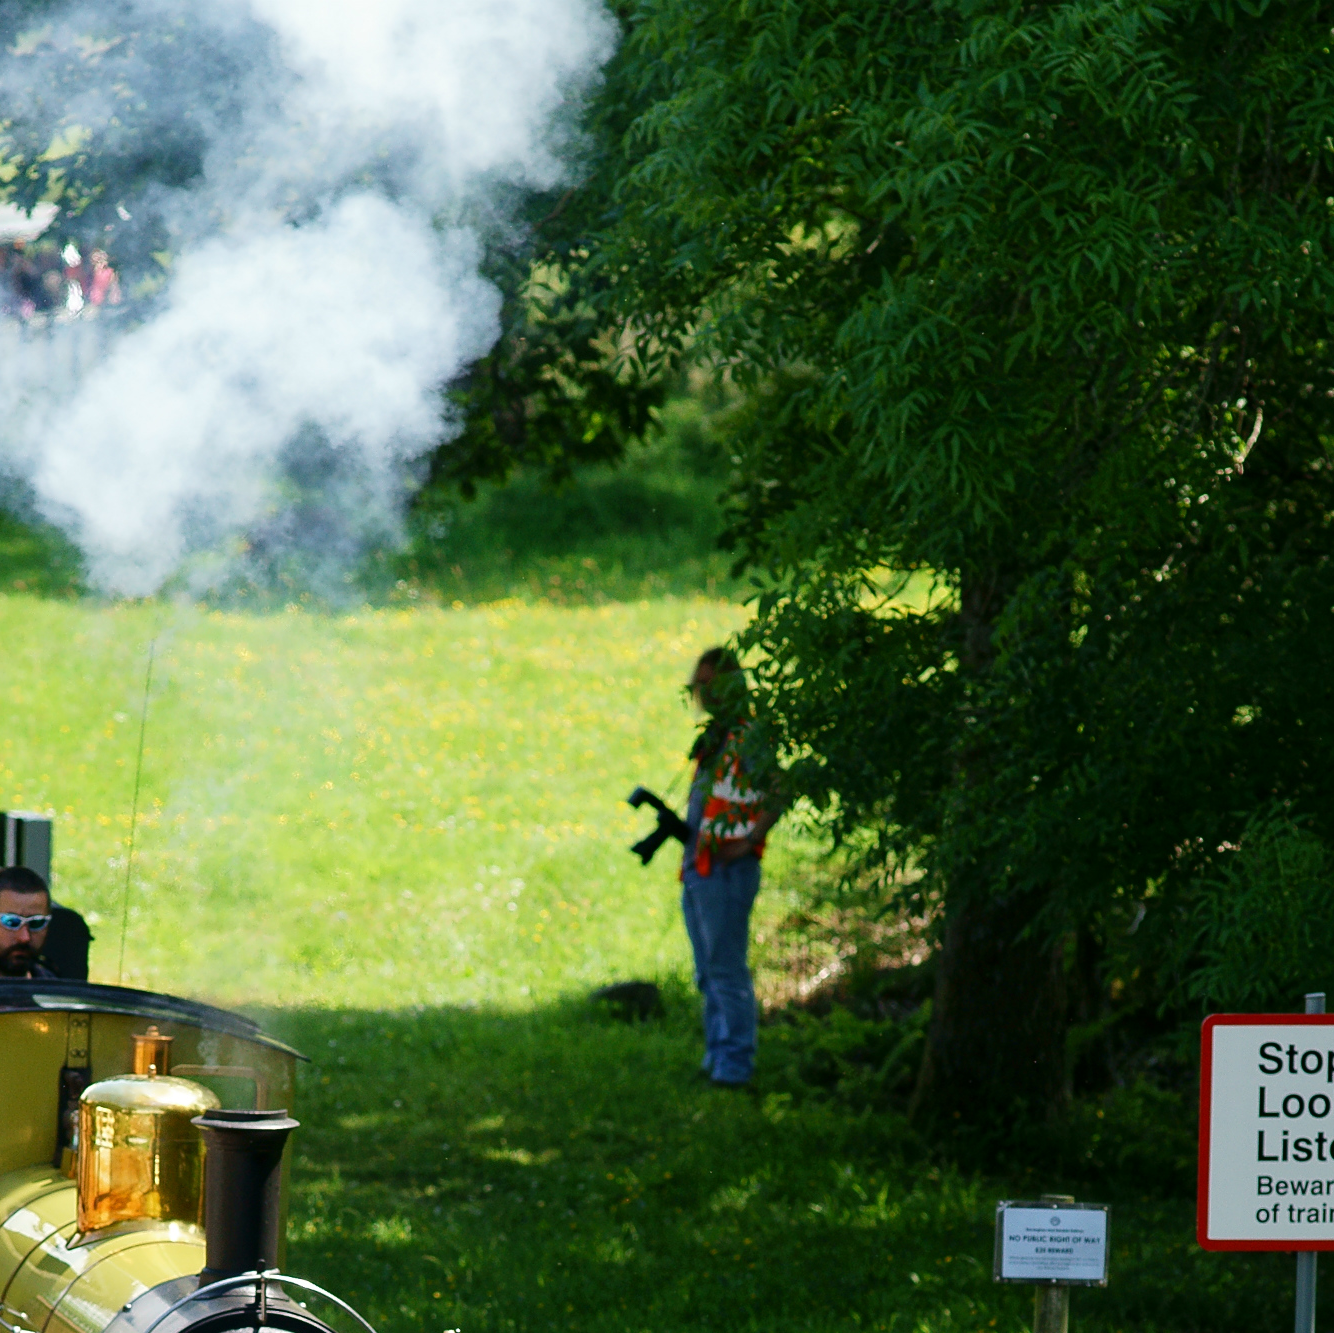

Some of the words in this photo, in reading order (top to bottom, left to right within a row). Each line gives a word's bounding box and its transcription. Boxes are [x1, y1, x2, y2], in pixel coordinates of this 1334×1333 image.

[1256, 1203, 1280, 1223] of
[1023, 1235, 1047, 1243] PUBLIC
[1072, 1236, 1082, 1244] OF
